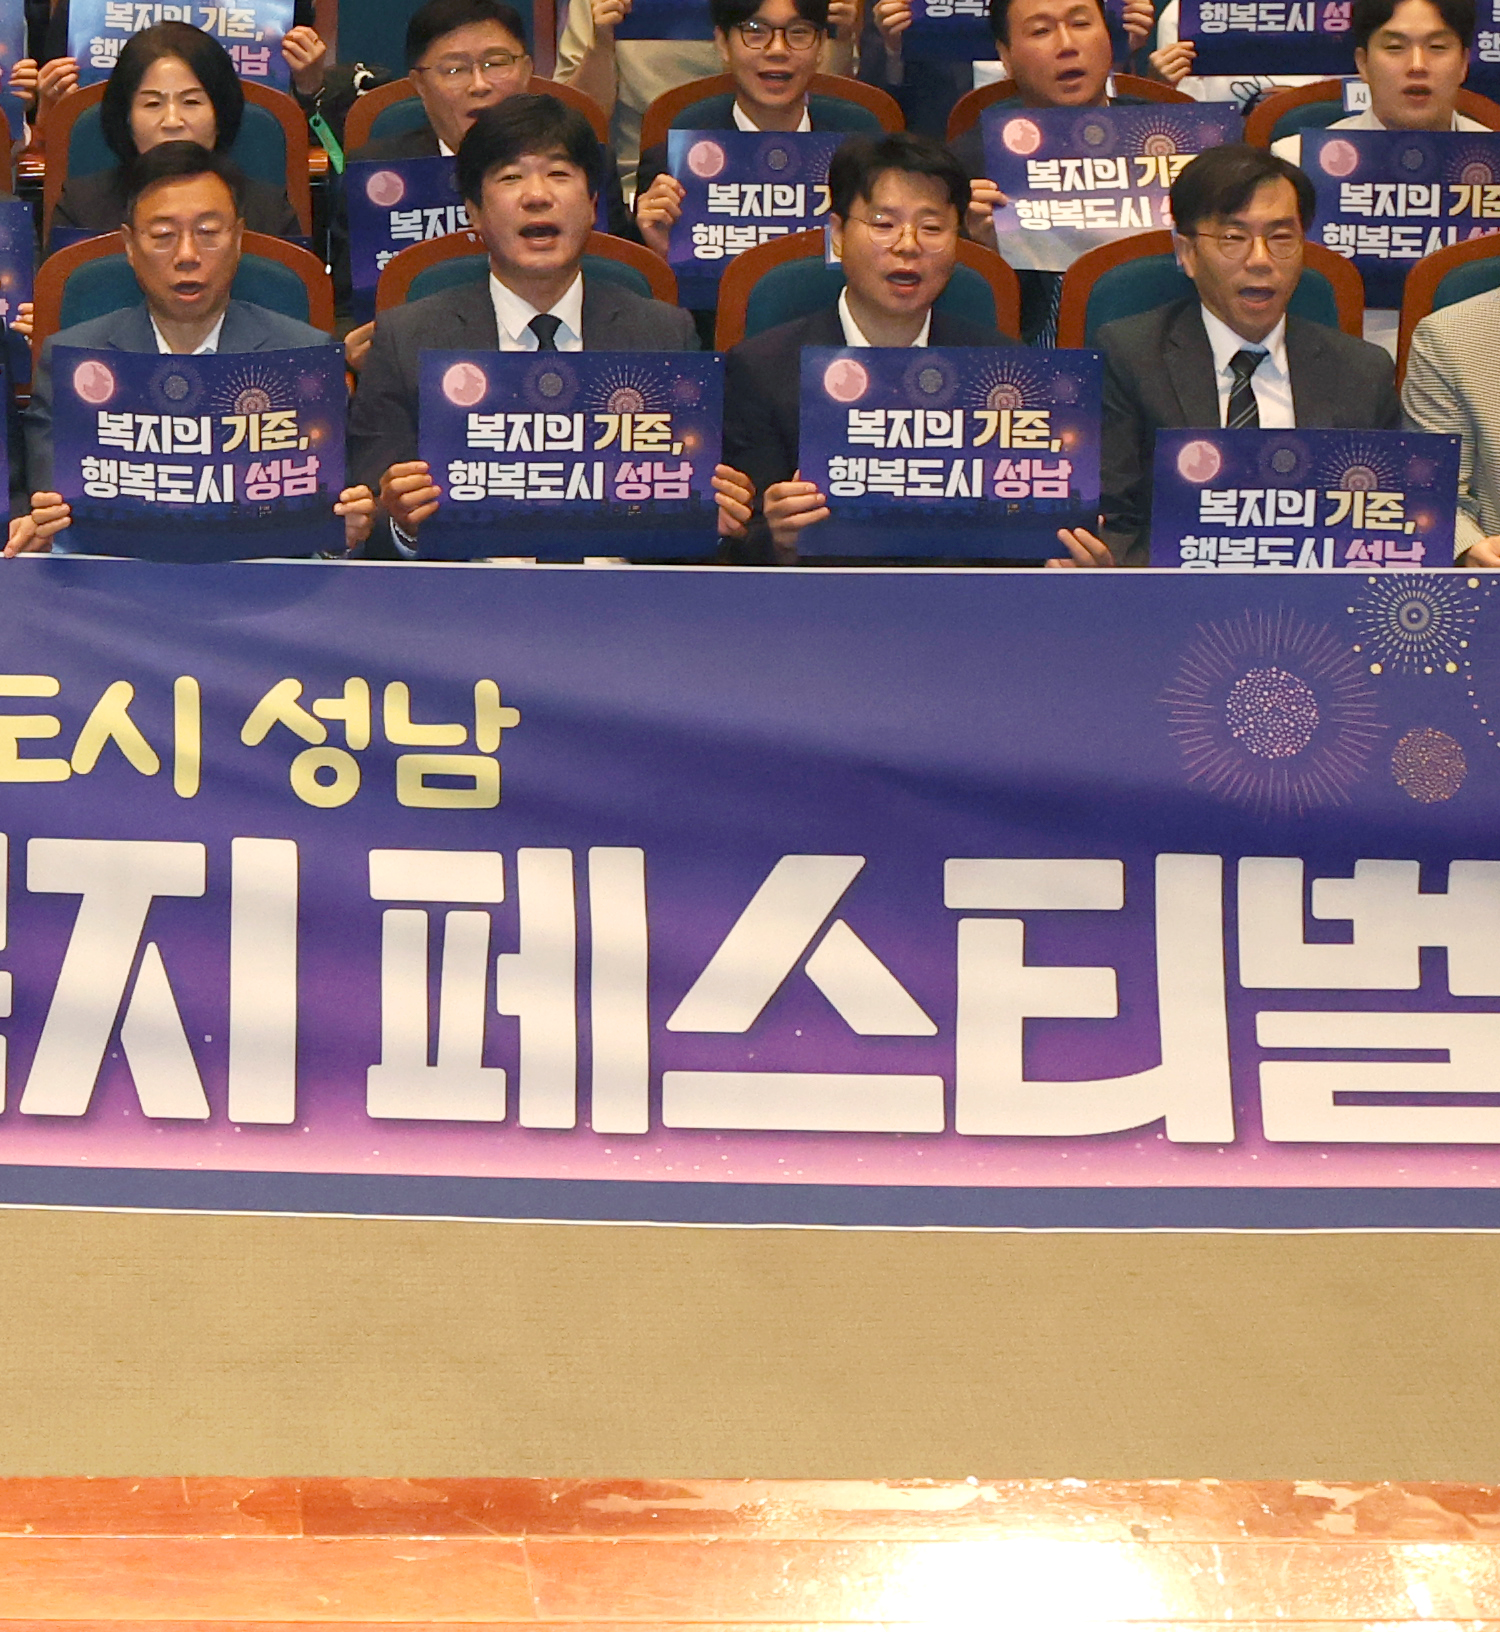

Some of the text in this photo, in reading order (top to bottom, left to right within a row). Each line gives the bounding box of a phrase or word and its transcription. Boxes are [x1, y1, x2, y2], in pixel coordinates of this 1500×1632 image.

[98, 411, 308, 454] 복지의 기준,
[467, 414, 682, 455] 복지의 기준,
[848, 409, 1061, 452] 복지의 기준,
[82, 456, 319, 503] 행복도시 성남
[448, 460, 693, 500] 행복도시 성남
[829, 456, 1071, 497] 행복도시 성남
[1198, 489, 1415, 533] 복지의 기준,
[1178, 535, 1334, 568] 행복도시
[240, 677, 520, 809] 성남
